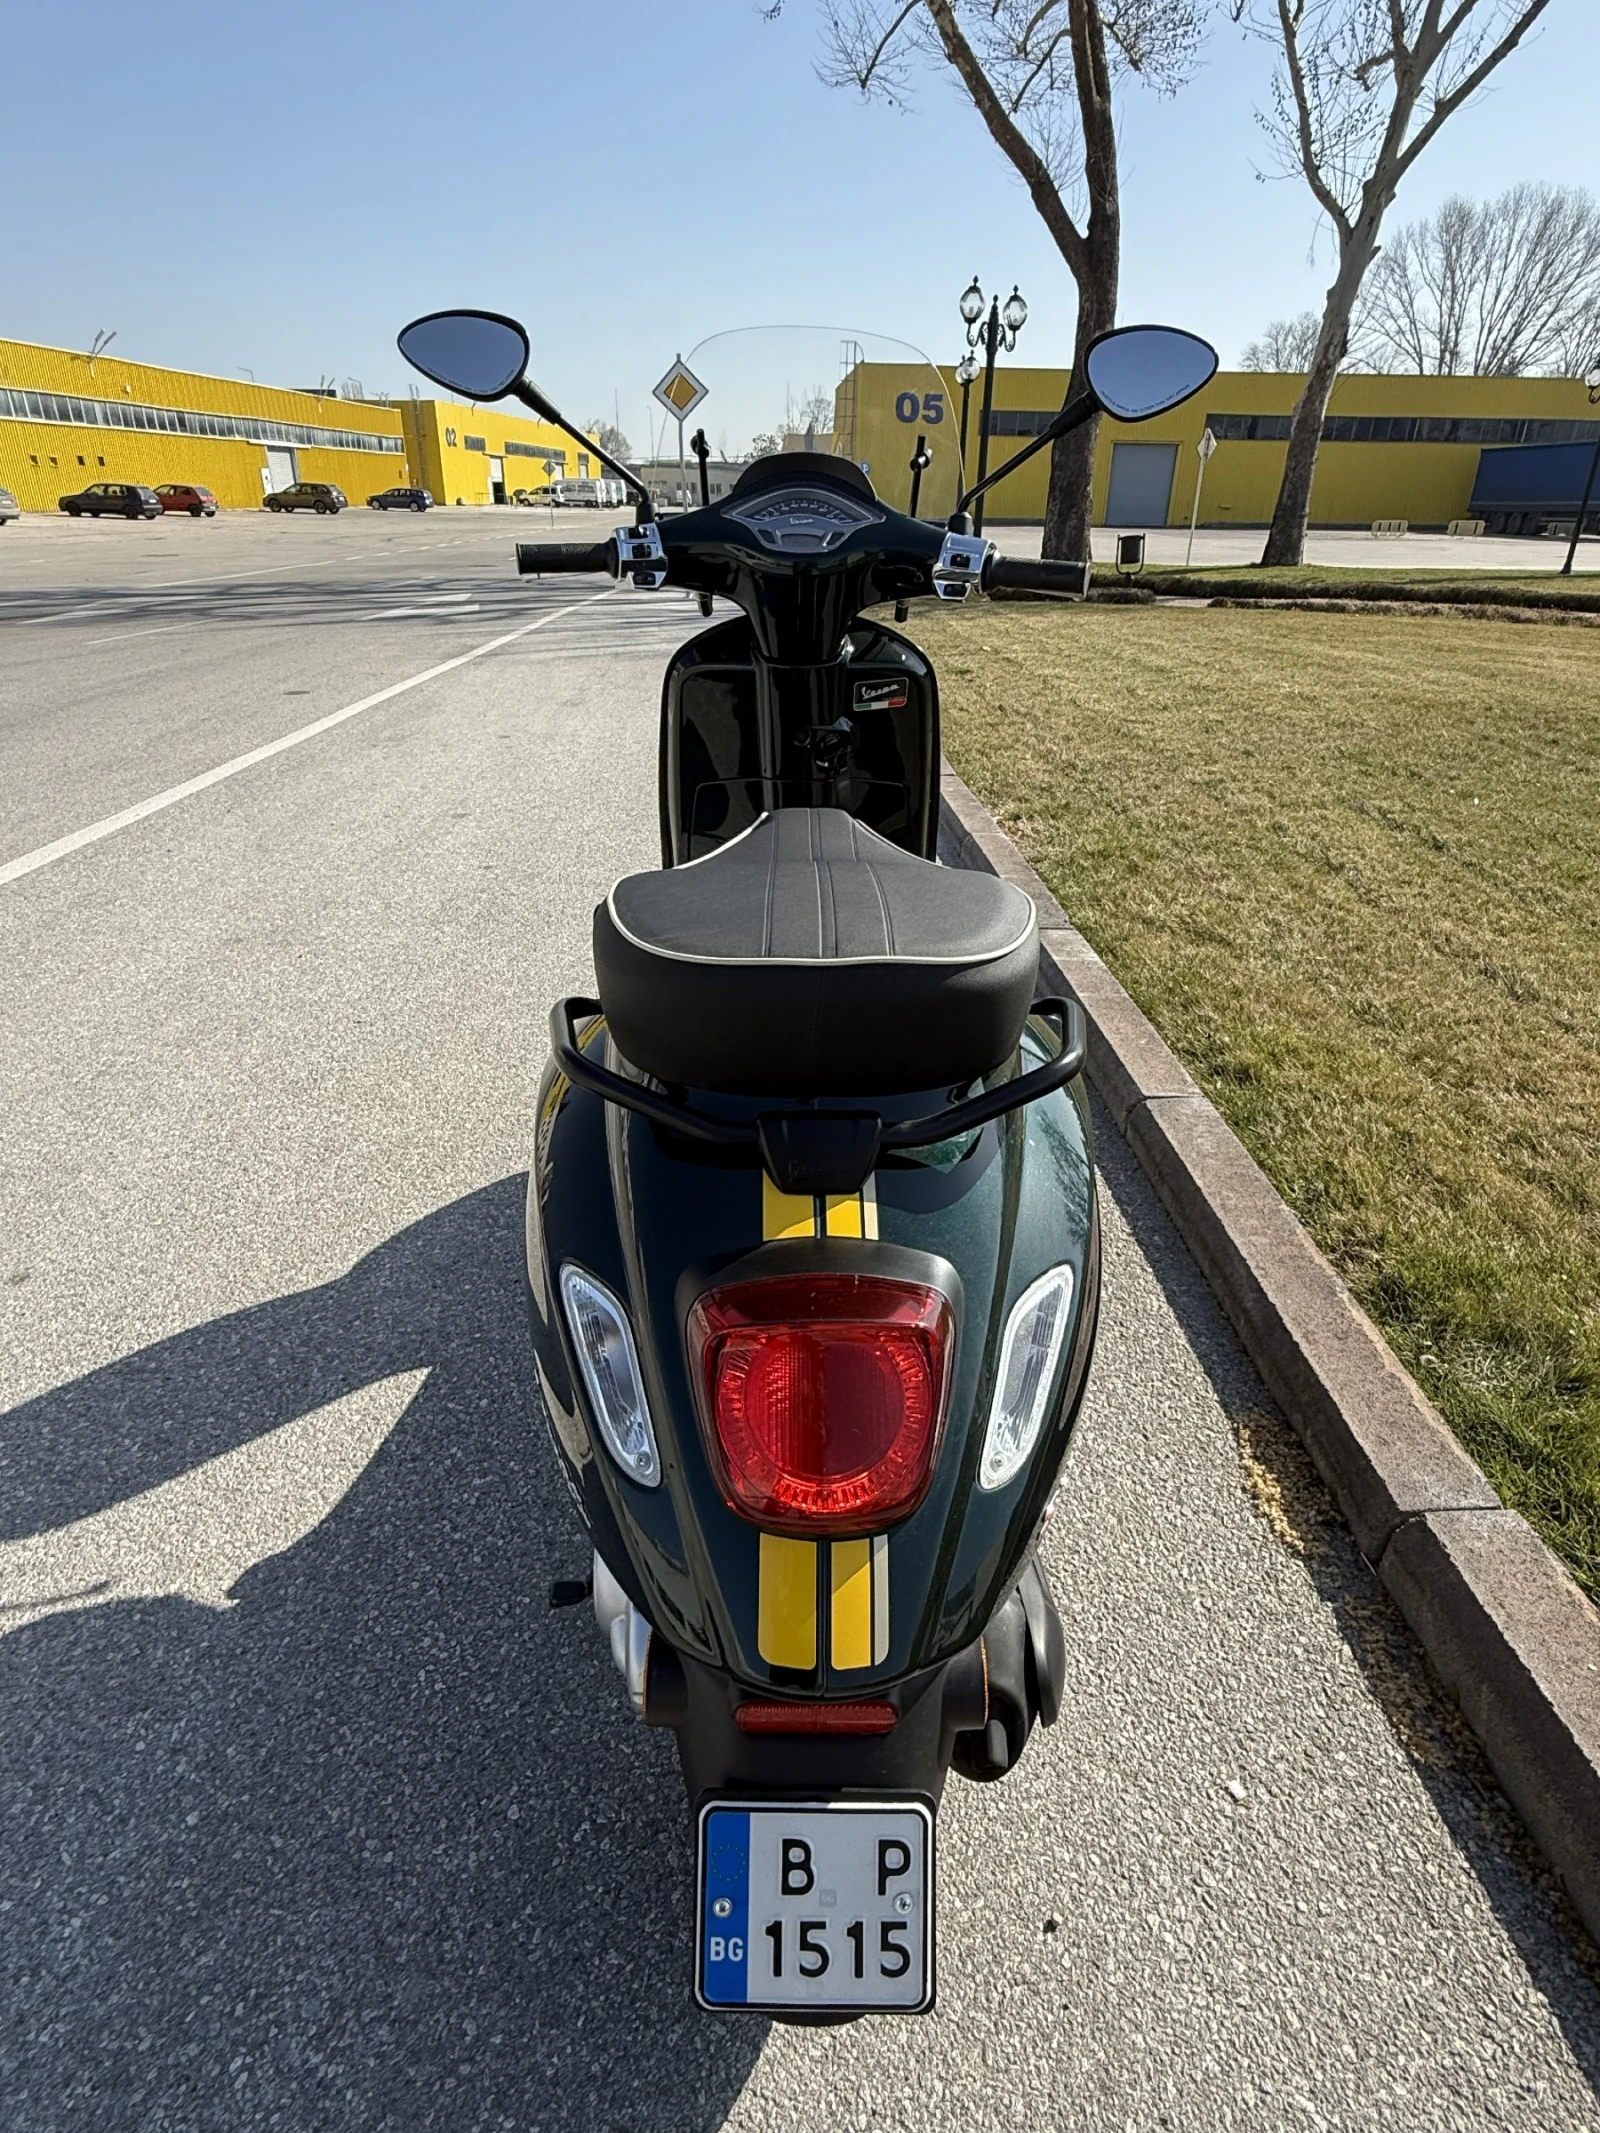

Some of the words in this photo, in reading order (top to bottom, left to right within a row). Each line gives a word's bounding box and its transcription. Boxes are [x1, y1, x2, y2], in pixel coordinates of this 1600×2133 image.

[895, 391, 944, 425] 05
[445, 426, 458, 448] 02
[861, 684, 900, 700] Vespa
[781, 1838, 815, 1896] B
[877, 1839, 911, 1896] P
[710, 1936, 744, 1962] BG
[765, 1920, 911, 1979] 1515
